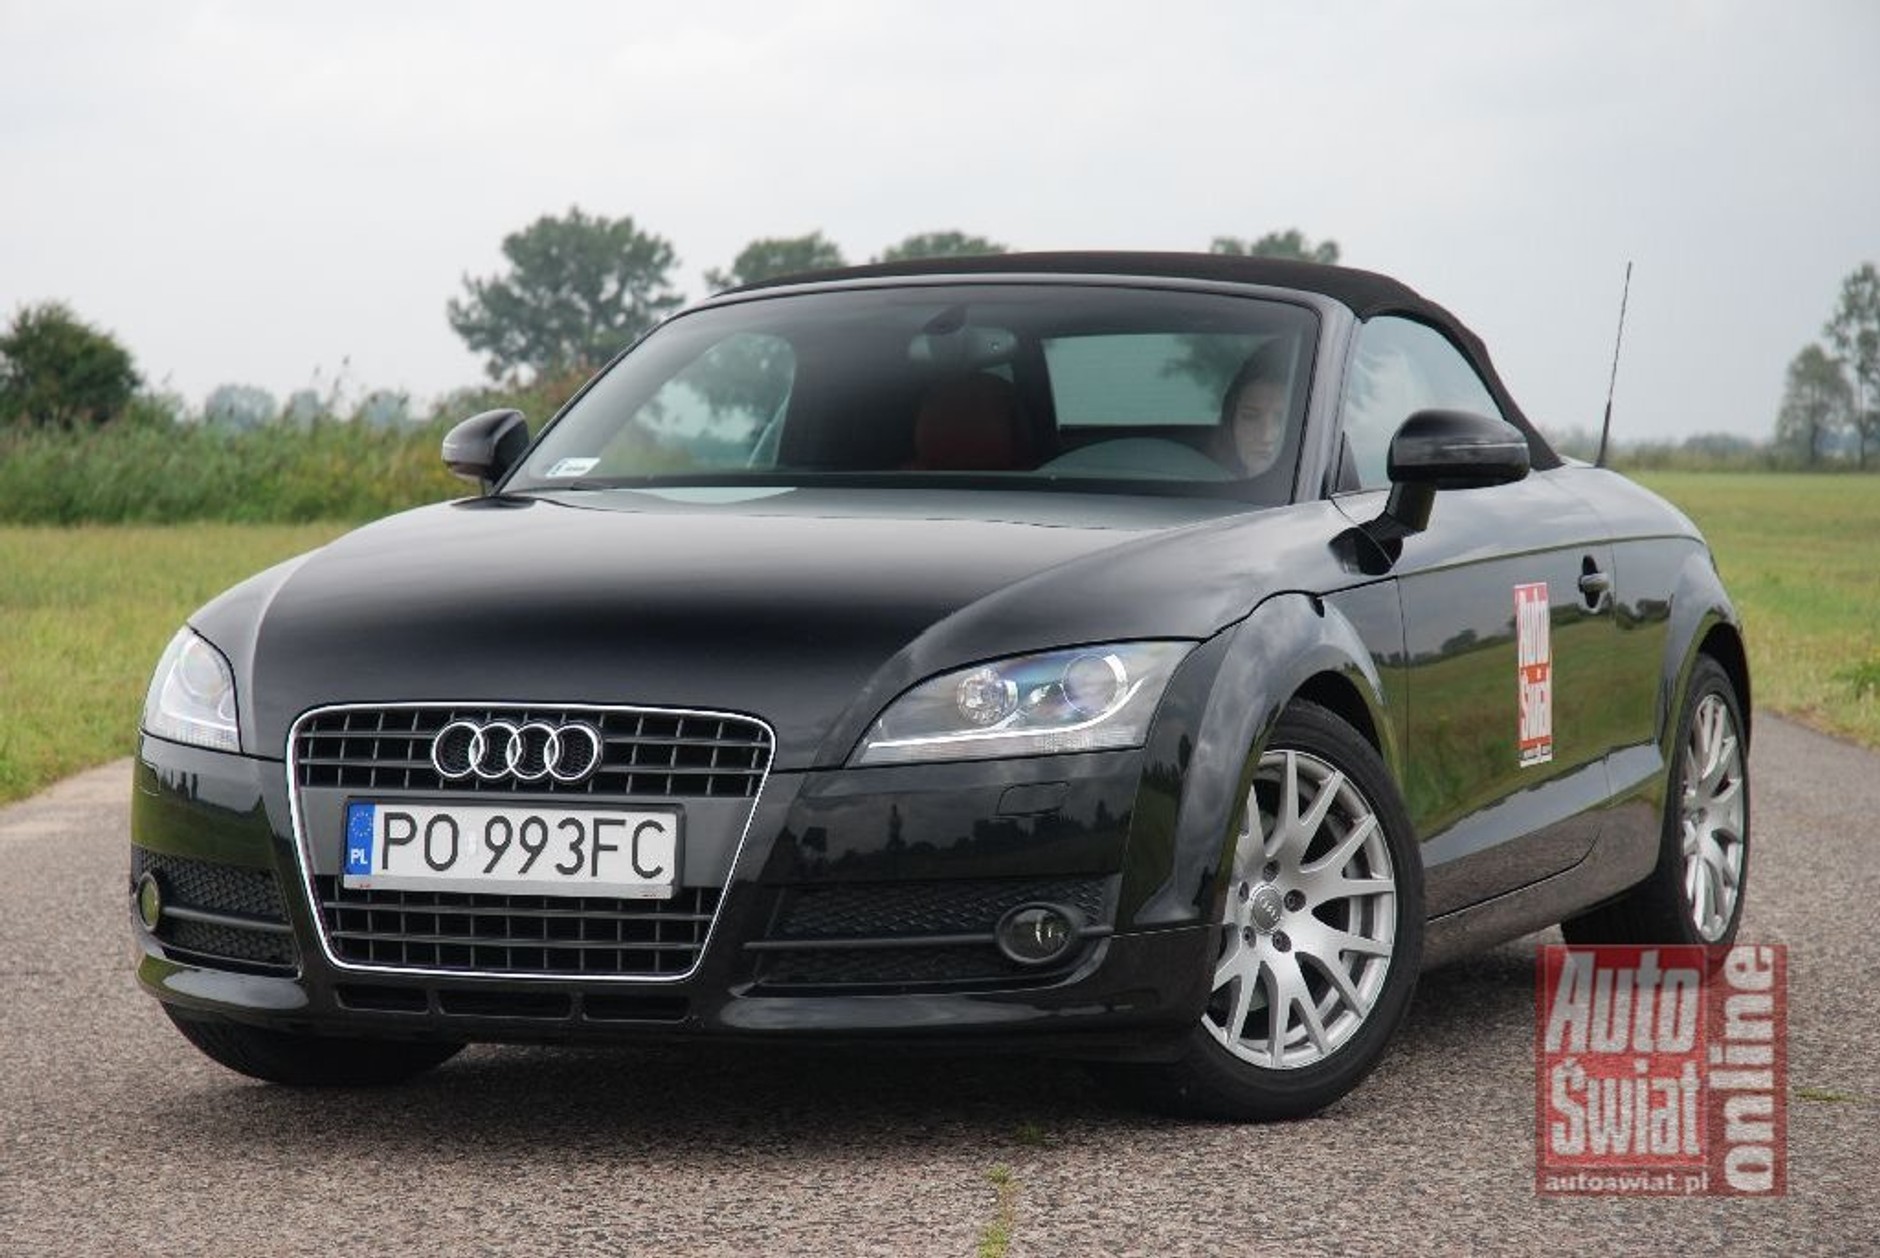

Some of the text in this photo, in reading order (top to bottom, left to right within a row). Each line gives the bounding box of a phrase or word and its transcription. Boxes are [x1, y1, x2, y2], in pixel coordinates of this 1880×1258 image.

[350, 848, 368, 865] PL
[381, 811, 665, 879] PO 993FC
